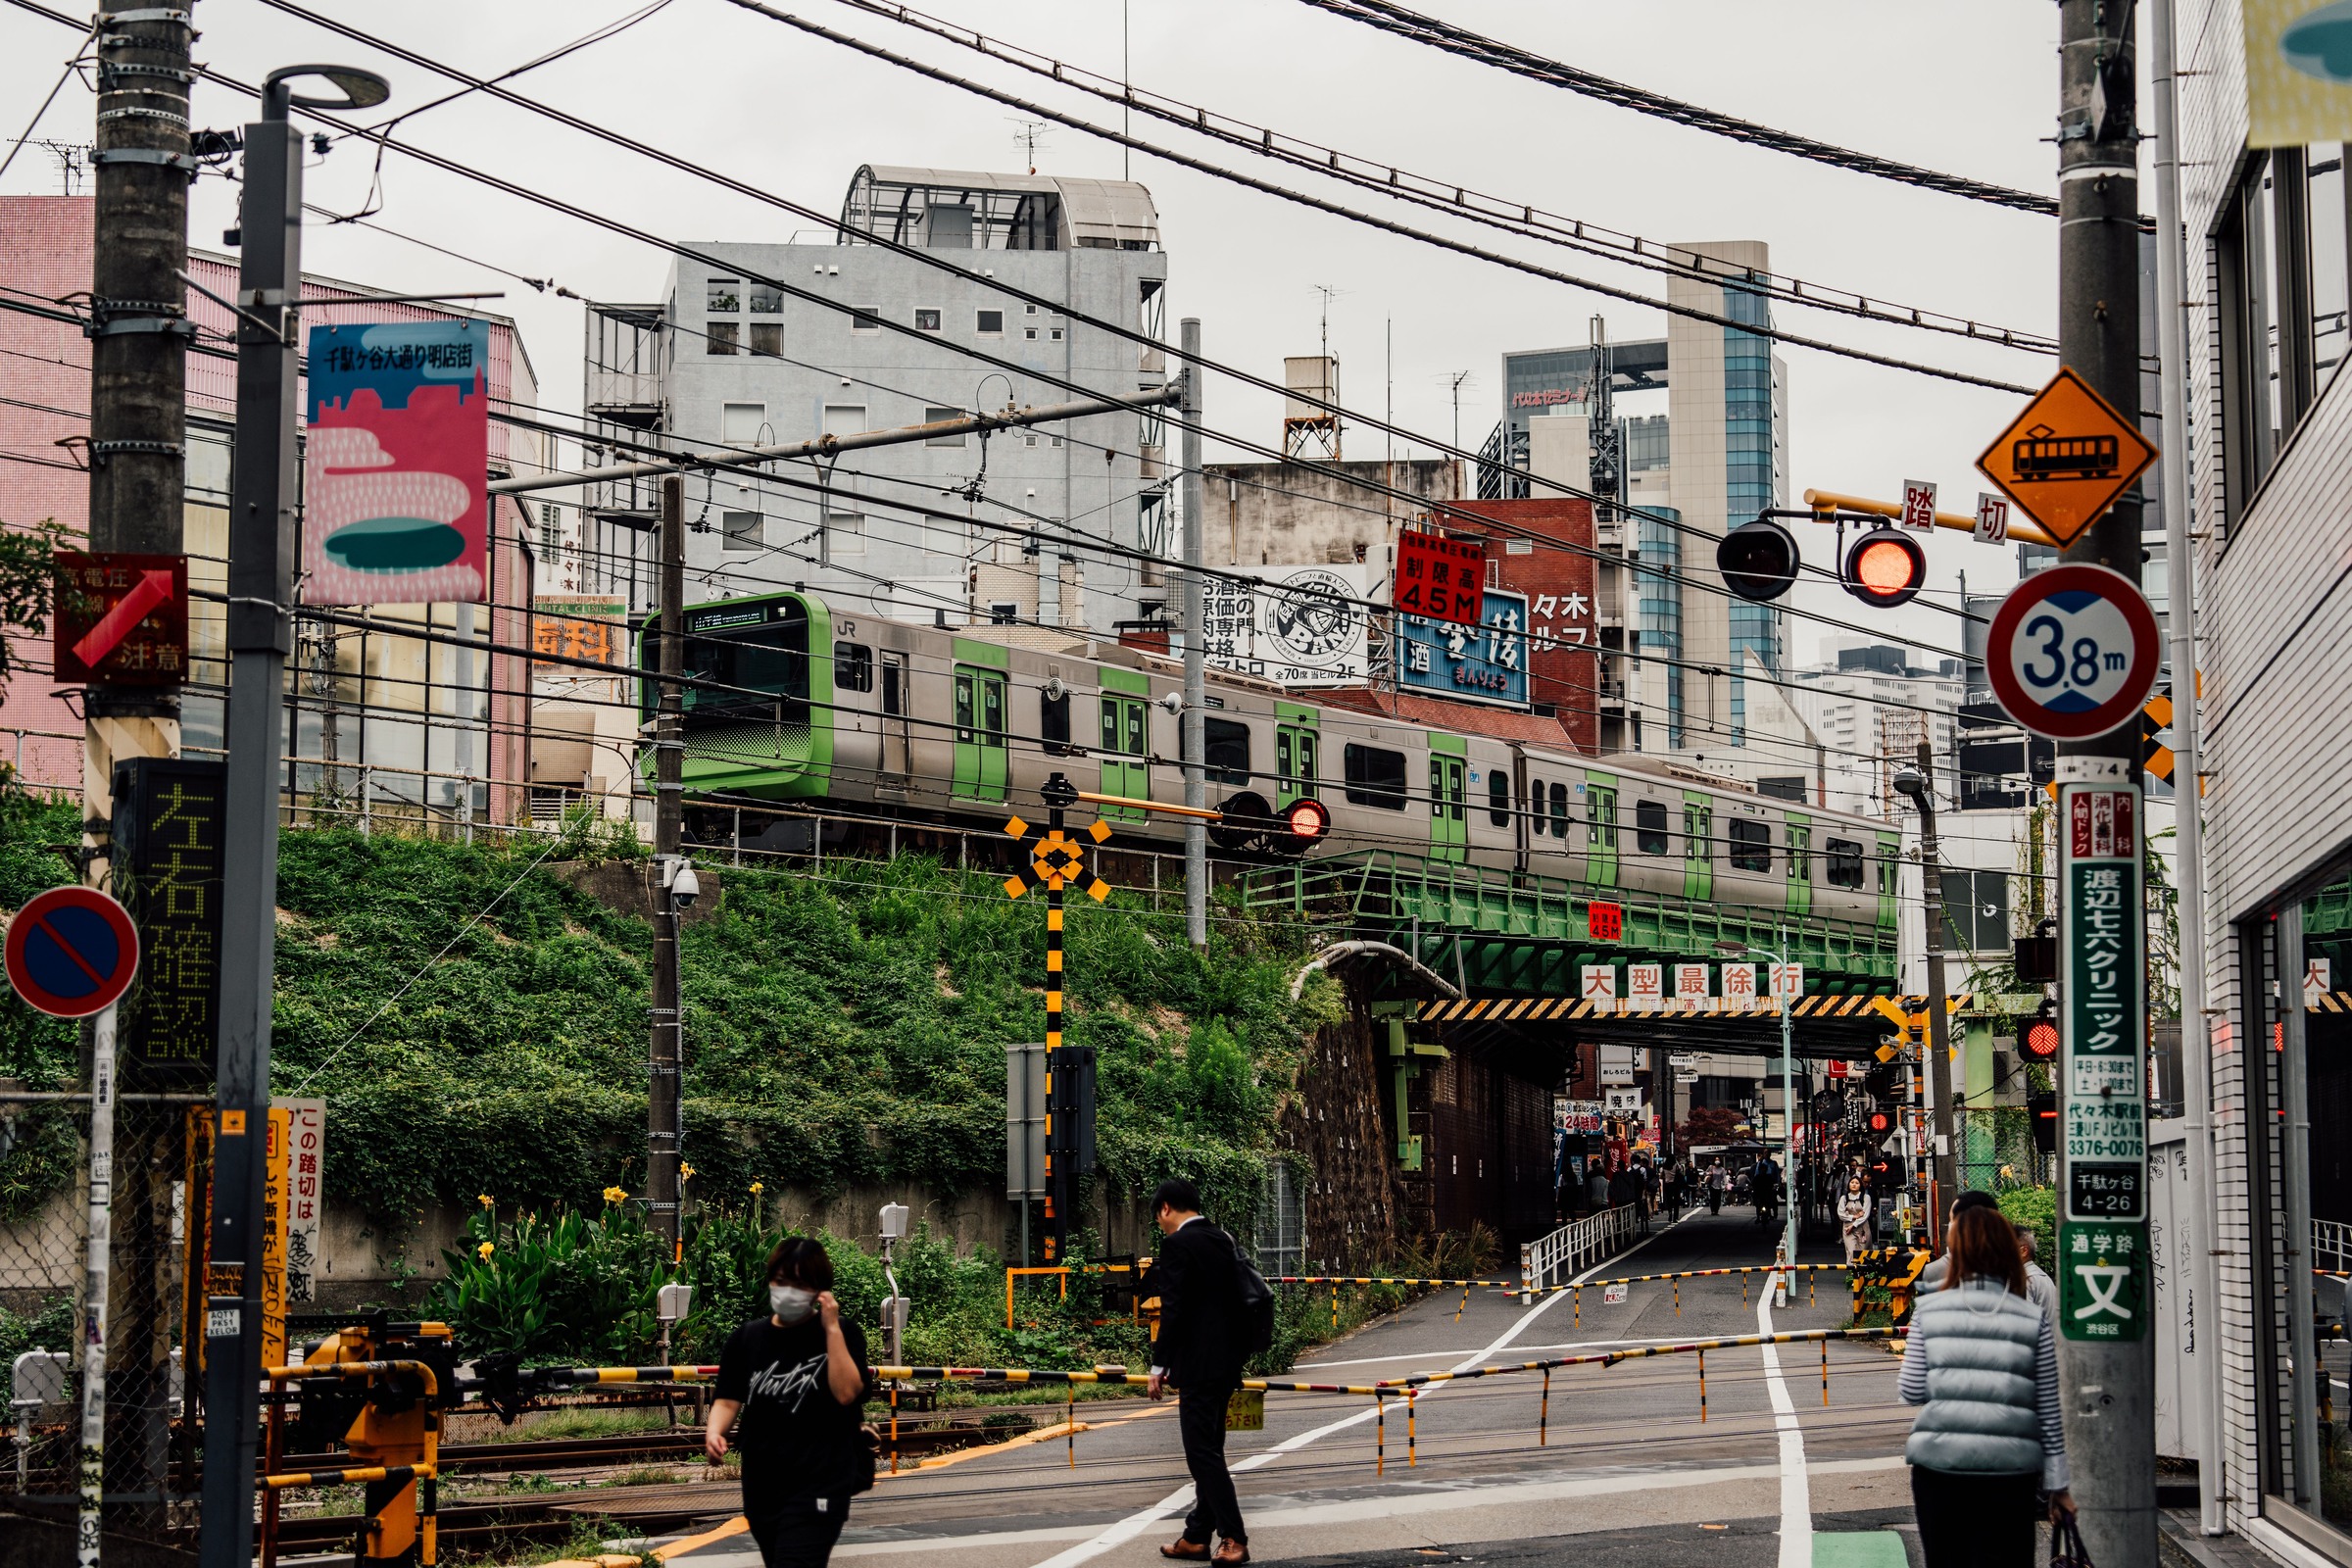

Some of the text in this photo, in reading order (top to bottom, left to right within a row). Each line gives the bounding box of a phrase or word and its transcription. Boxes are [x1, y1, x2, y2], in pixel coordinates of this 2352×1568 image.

[1905, 486, 2008, 541] 踏切
[1405, 556, 1475, 590] 制限高
[1402, 583, 1475, 620] 4.5M
[1533, 592, 1589, 619] 々木
[837, 620, 856, 637] JR
[122, 642, 183, 671] 注意
[1275, 667, 1308, 680] 全70席
[1454, 666, 1508, 691] きんりょう
[2073, 796, 2089, 855] 人間ドック
[2117, 796, 2132, 854] 内科
[148, 783, 215, 1058] 左右確認
[2083, 868, 2123, 1051] 渡辺七六クリニック
[1585, 966, 1800, 996] 大型最徐行
[1566, 1115, 1599, 1131] 24時間
[2069, 1102, 2141, 1119] 代々木駅前
[2069, 1140, 2143, 1156] 3376-0076
[298, 1108, 318, 1219] この踏切は
[2082, 1195, 2131, 1210] 4-26
[2071, 1234, 2133, 1253] 通学路
[2086, 1323, 2119, 1335] 渋谷区
